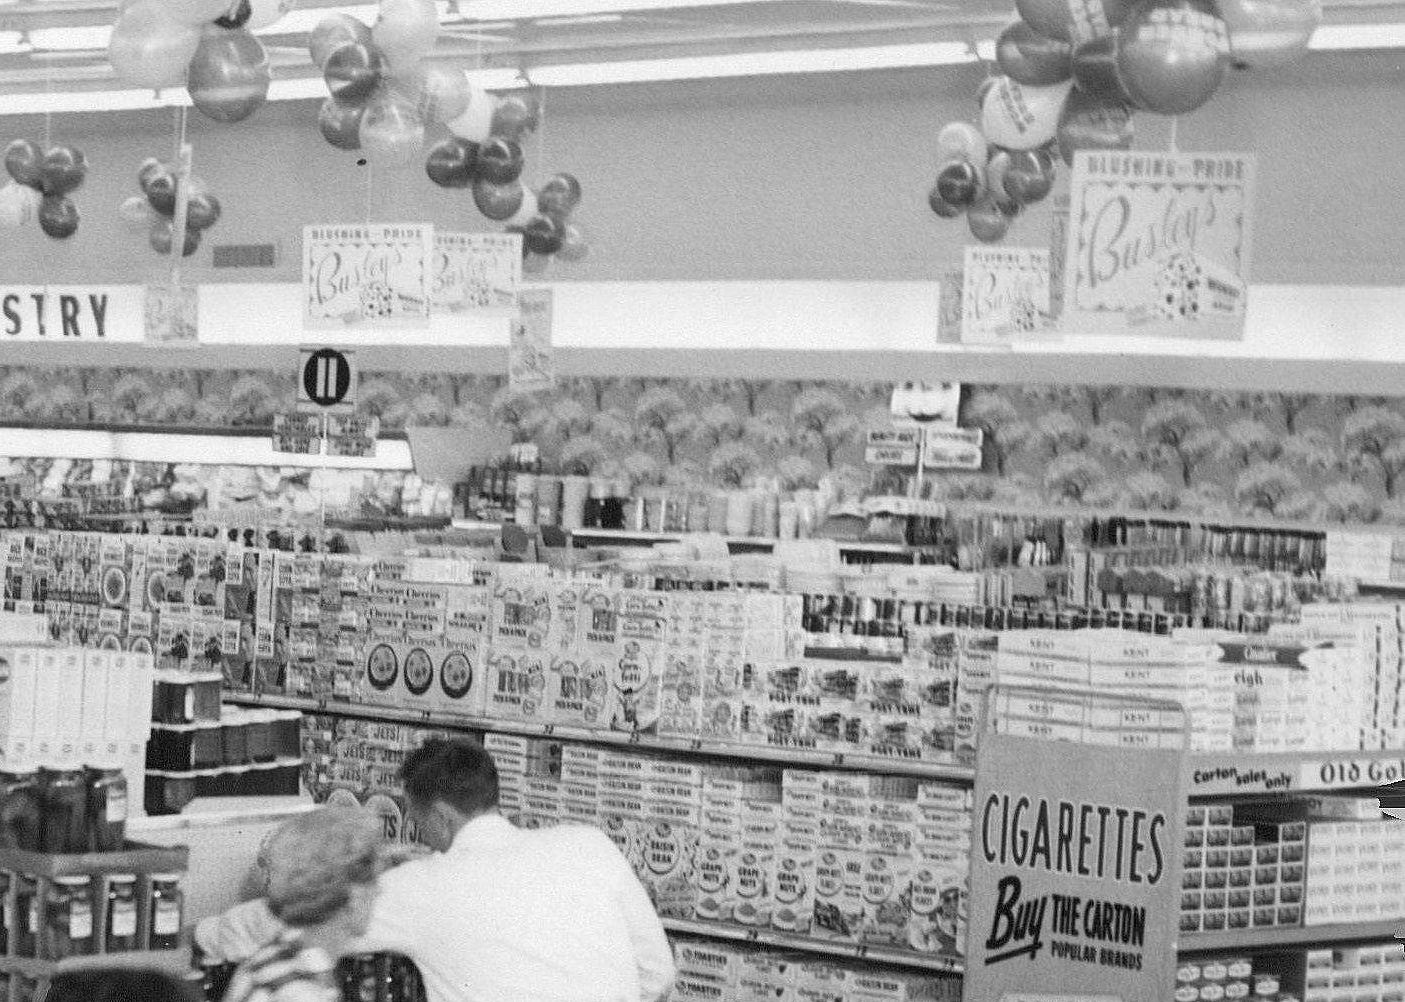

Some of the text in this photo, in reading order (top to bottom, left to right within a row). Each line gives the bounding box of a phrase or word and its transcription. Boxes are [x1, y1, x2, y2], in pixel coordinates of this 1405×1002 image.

[1087, 155, 1244, 180] BLUSHING PRIDE
[311, 228, 422, 240] BLUSHING PRIDE
[315, 356, 338, 400] 11
[1193, 766, 1292, 790] Carton sales only
[1319, 757, 1405, 785] Old Gol
[379, 813, 397, 839] TS
[650, 840, 675, 852] RAISIN
[982, 793, 1166, 886] CIGARETTES
[652, 852, 672, 864] BRAN
[985, 875, 1147, 961] Buy THE CARTON
[1051, 940, 1144, 972] POPULAR BRANDS
